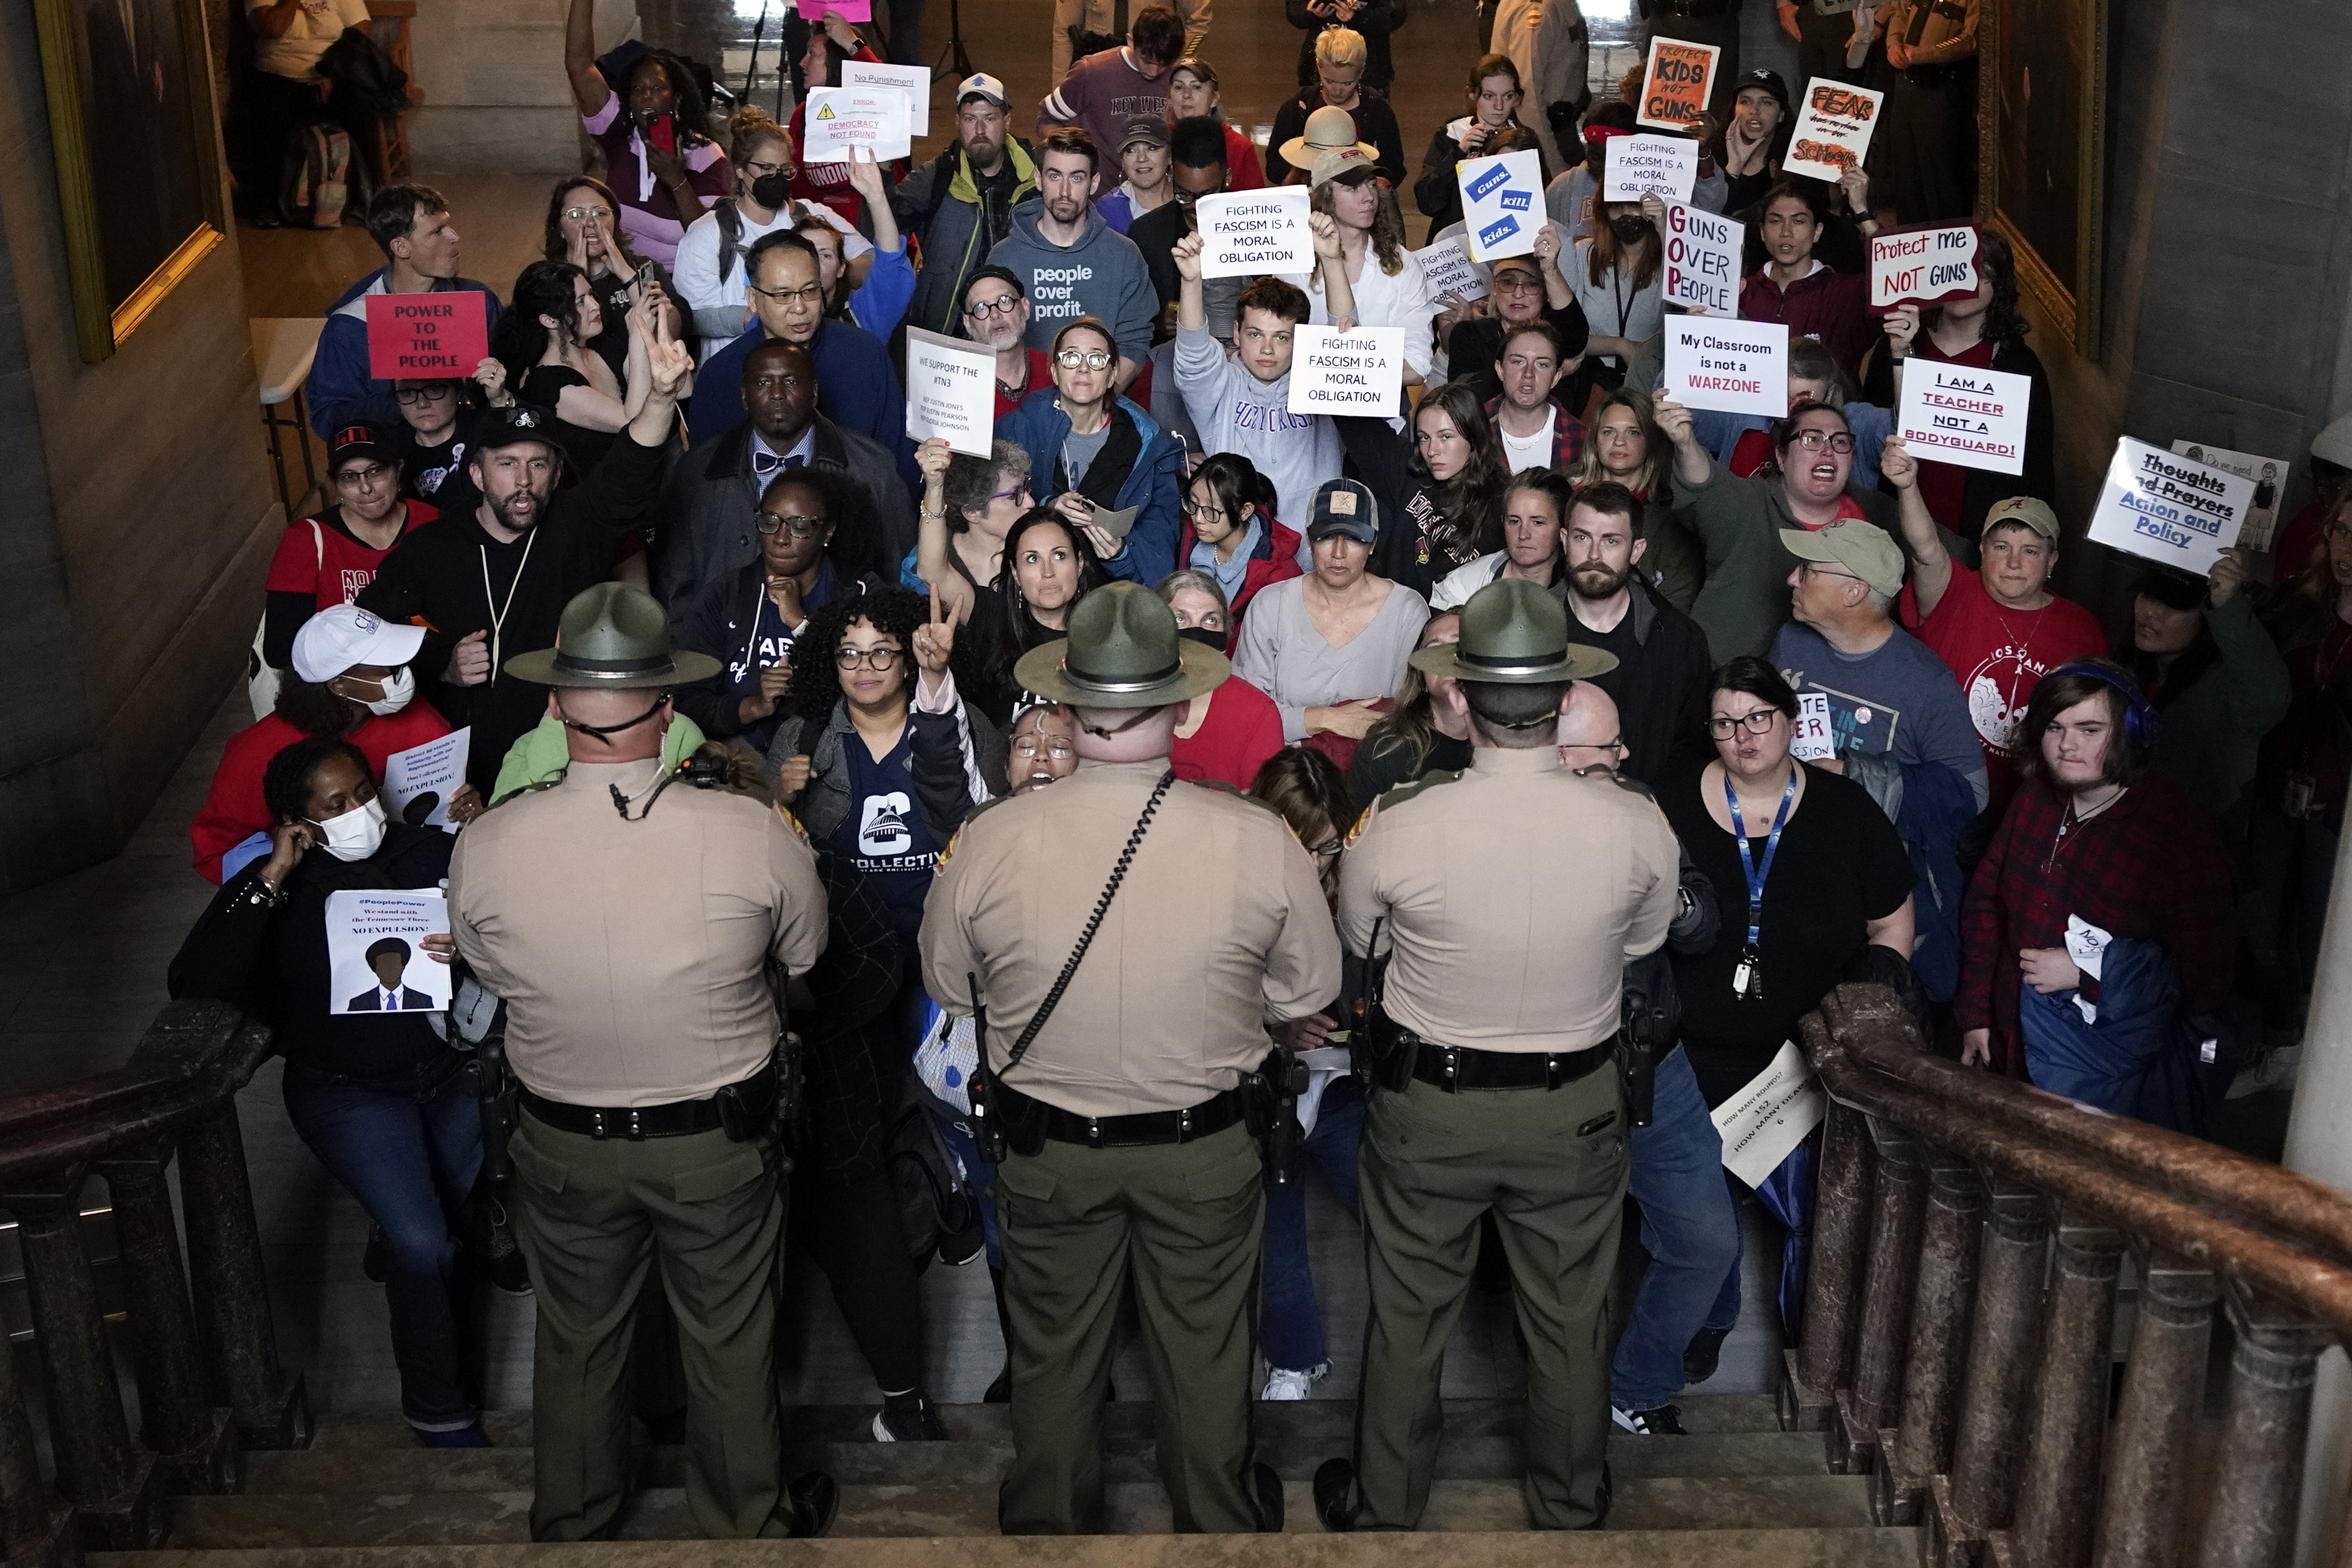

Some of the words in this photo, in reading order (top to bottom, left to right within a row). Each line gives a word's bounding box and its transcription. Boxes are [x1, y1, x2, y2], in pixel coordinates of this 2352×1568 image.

[1660, 46, 1710, 60] PROTECT
[1656, 57, 1704, 84] KIDS
[868, 75, 914, 86] Punishment
[1661, 83, 1690, 95] NOT
[1111, 96, 1137, 115] KEY
[1140, 96, 1169, 114] WES
[1648, 96, 1696, 120] GUNS
[1812, 86, 1874, 121] FEAR
[828, 120, 879, 129] DEMOCRACY
[1630, 143, 1675, 154] FIGHTING
[1620, 157, 1661, 166] FASCISM
[1665, 160, 1674, 168] IS
[1677, 162, 1683, 170] A
[806, 162, 850, 186] FUNDIN
[1478, 171, 1508, 194] Guns.
[1634, 171, 1667, 180] MORAL
[1620, 183, 1677, 195] OBLIGATION
[1226, 204, 1282, 216] FIGHTING
[1215, 220, 1266, 232] FASCISM
[1272, 220, 1282, 229] IS
[1286, 219, 1295, 229] A
[1669, 206, 1728, 244] GUNS
[1234, 236, 1277, 247] MORAL
[1484, 227, 1512, 245] Kids.
[1219, 250, 1293, 263] OBLIGATION
[1421, 245, 1461, 266] FIGHTING
[1874, 235, 1930, 261] Protect
[1426, 261, 1457, 279] ASCISM
[1457, 257, 1467, 266] IS
[1668, 238, 1730, 283] OVER
[1034, 265, 1092, 285] people
[1437, 271, 1468, 288] MORAL
[1884, 265, 1925, 297] NOT
[1930, 262, 1967, 286] GUNS
[1034, 286, 1073, 300] over
[1433, 278, 1484, 304] OBLATION
[1669, 266, 1730, 311] PEOPLE
[394, 305, 453, 318] POWER
[1035, 301, 1085, 321] profit.
[413, 322, 436, 334] TO
[411, 339, 441, 350] THE
[1322, 339, 1376, 350] FIGHTING
[1681, 334, 1700, 349] My
[1704, 336, 1771, 354] Classroom
[399, 355, 459, 367] PEOPLE
[919, 356, 928, 366] WE
[929, 360, 961, 374] SUPPORT
[963, 367, 979, 378] THE
[1309, 356, 1360, 367] FASCISM
[1365, 358, 1374, 368] IS
[1378, 358, 1386, 368] A
[1701, 356, 1711, 368] is
[1715, 361, 1736, 371] not
[934, 376, 951, 387] #TN3
[1326, 374, 1367, 385] MORAL
[1689, 375, 1760, 393] WARZONE
[1936, 373, 1942, 384] I
[1950, 377, 1975, 390] AM
[1982, 382, 1994, 393] A
[1309, 390, 1380, 402] OBLIGATION
[1923, 393, 2003, 414] TEACHER
[941, 411, 968, 421] PEARSON
[1934, 414, 1970, 428] NOT
[1977, 422, 1988, 432] A
[940, 422, 969, 431] JOHNSON
[1905, 429, 2015, 455] BODYGUARD!
[2143, 454, 2227, 494] Thoughts
[2135, 475, 2160, 492] nd
[2162, 481, 2234, 517] Prayers
[2136, 516, 2193, 548] Policy
[2184, 514, 2222, 534] and
[1796, 718, 1824, 739] ER
[1982, 719, 2009, 733] STE
[1794, 745, 1829, 757] SSION
[410, 773, 455, 791] EXPULSION!
[1722, 1112, 1738, 1127] HOW
[1738, 1097, 1756, 1114] MANY
[1757, 1072, 1783, 1098] ROUNDS?
[1754, 1100, 1771, 1116] 152
[1734, 1130, 1755, 1152] HOW
[1756, 1105, 1780, 1130] MANY
[1781, 1080, 1808, 1105] DEAD?
